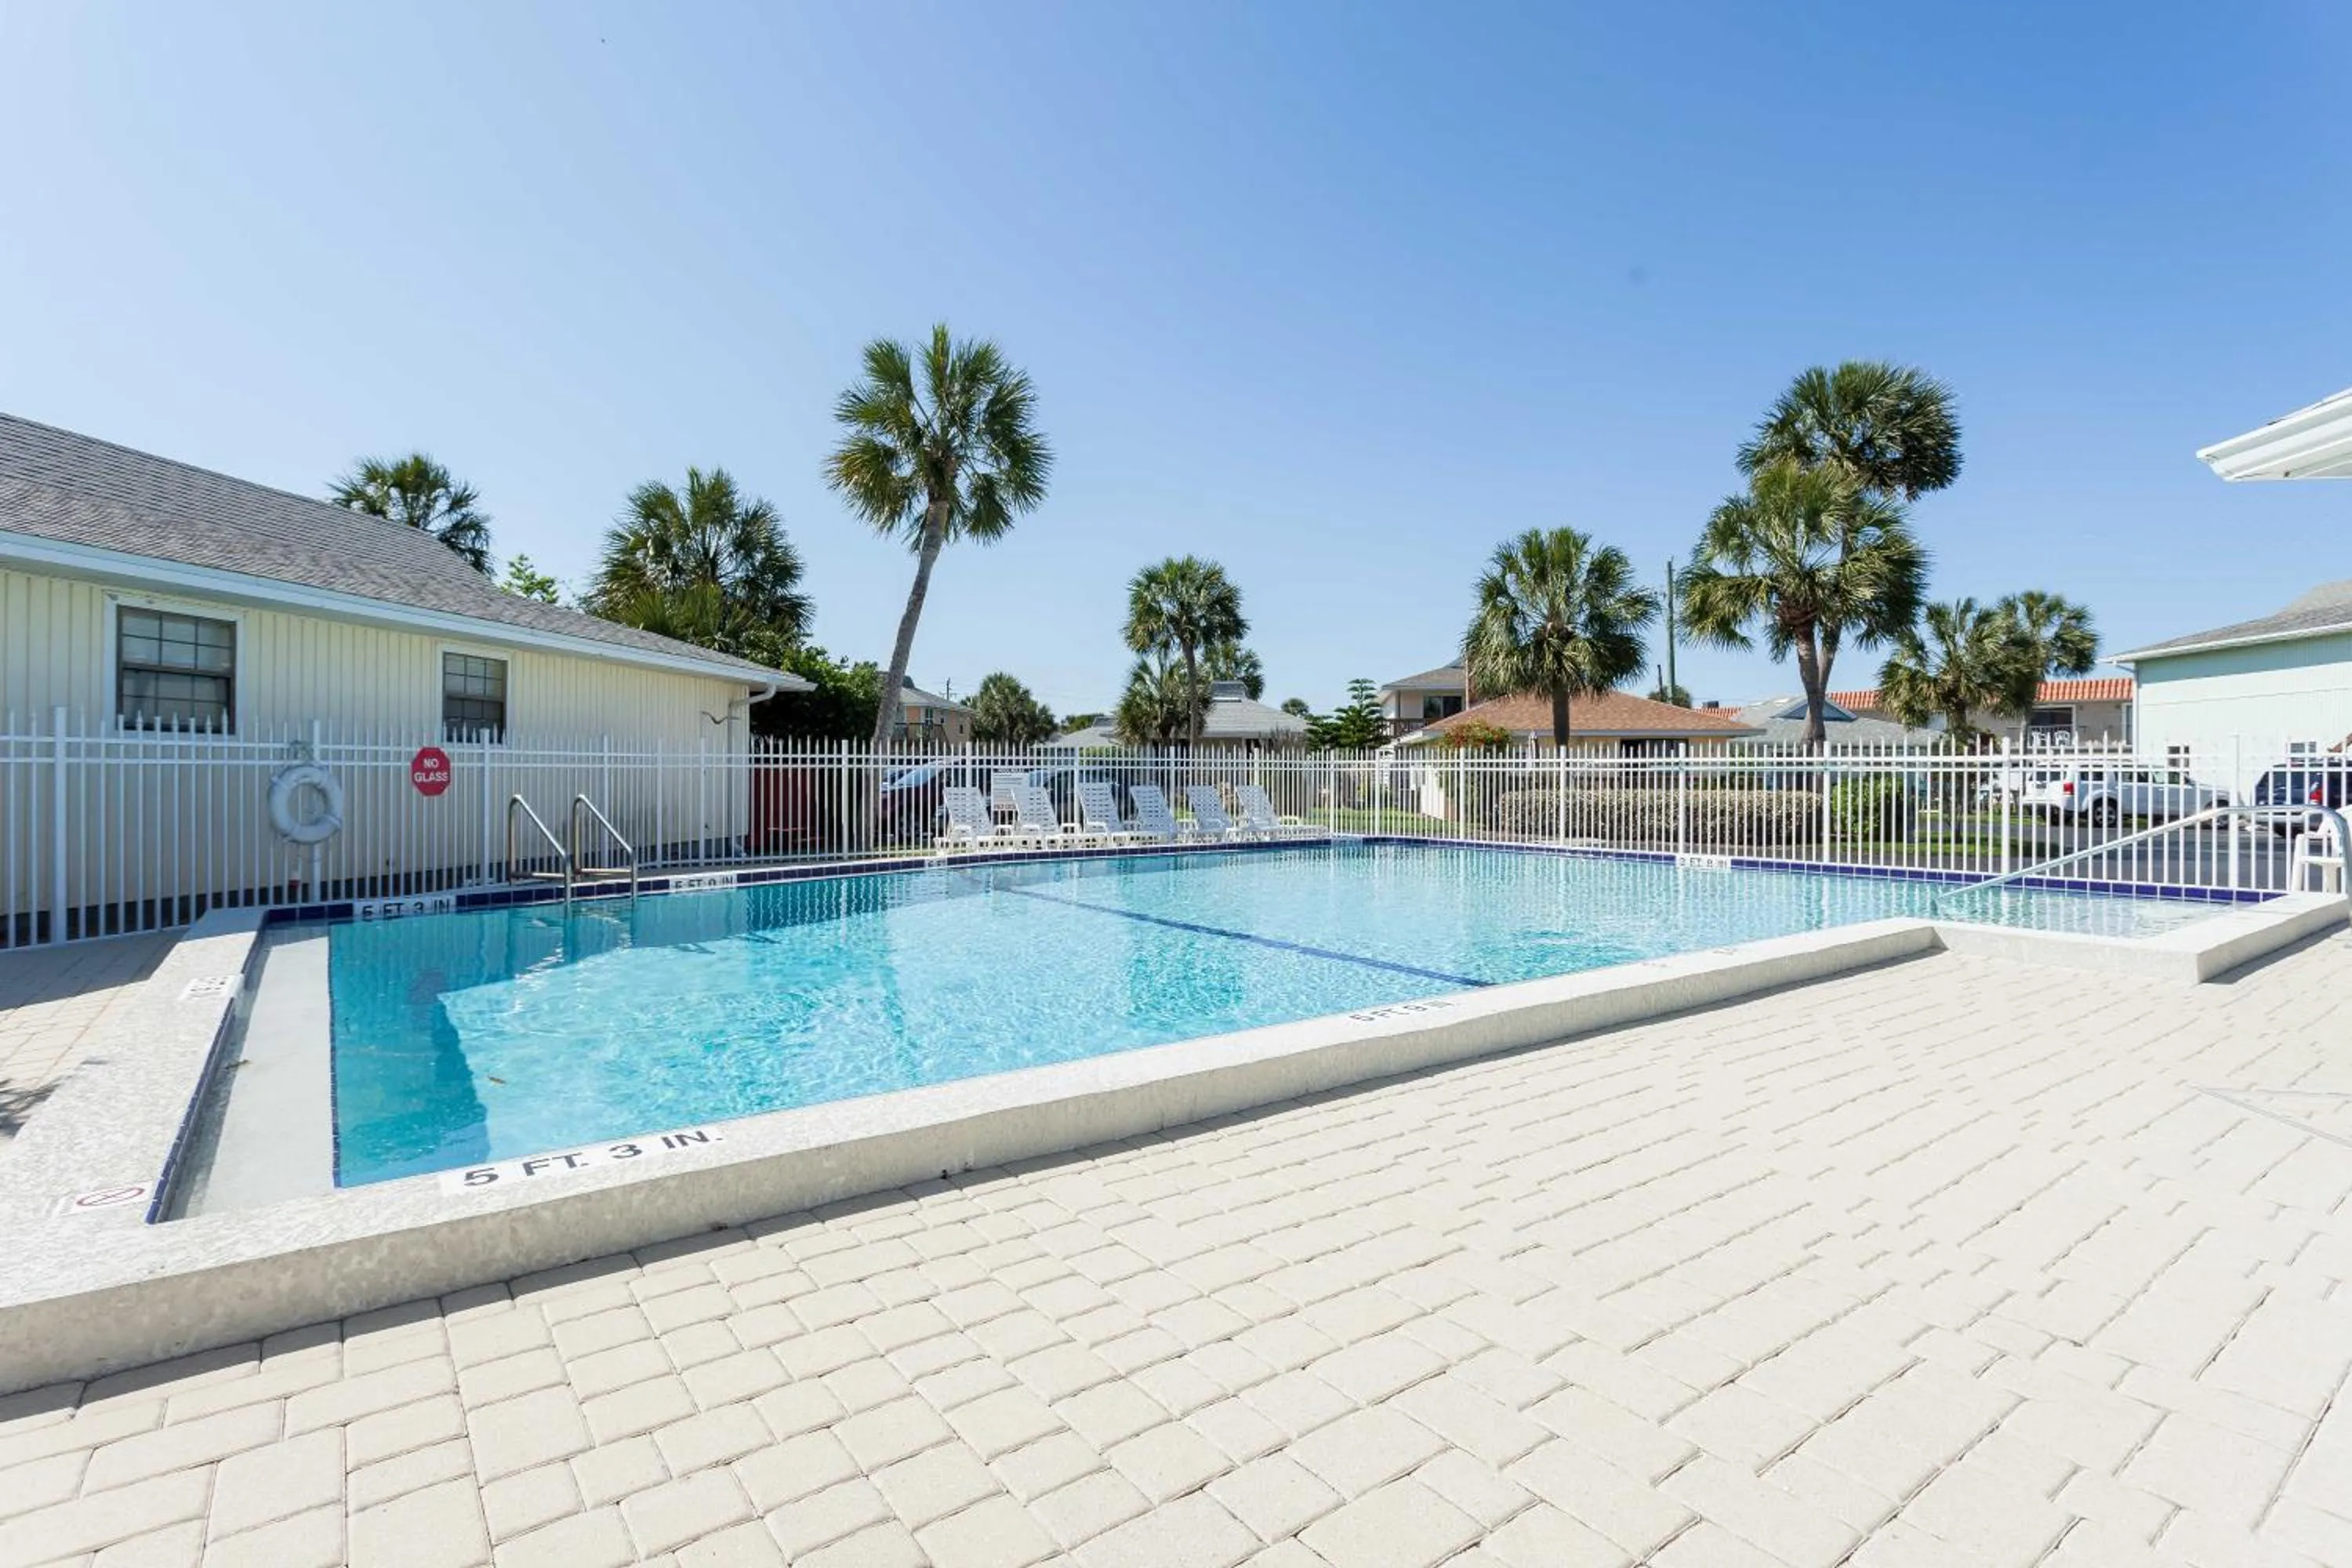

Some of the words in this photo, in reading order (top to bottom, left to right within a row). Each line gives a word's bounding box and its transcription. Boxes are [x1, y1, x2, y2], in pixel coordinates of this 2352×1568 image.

[423, 758, 439, 768] NO
[414, 771, 448, 782] GLASS
[383, 902, 405, 916] FT
[434, 898, 451, 915] IN
[463, 1167, 499, 1186] 5
[522, 1152, 590, 1177] FT.
[608, 1143, 643, 1160] 3
[660, 1129, 724, 1150] IN.
